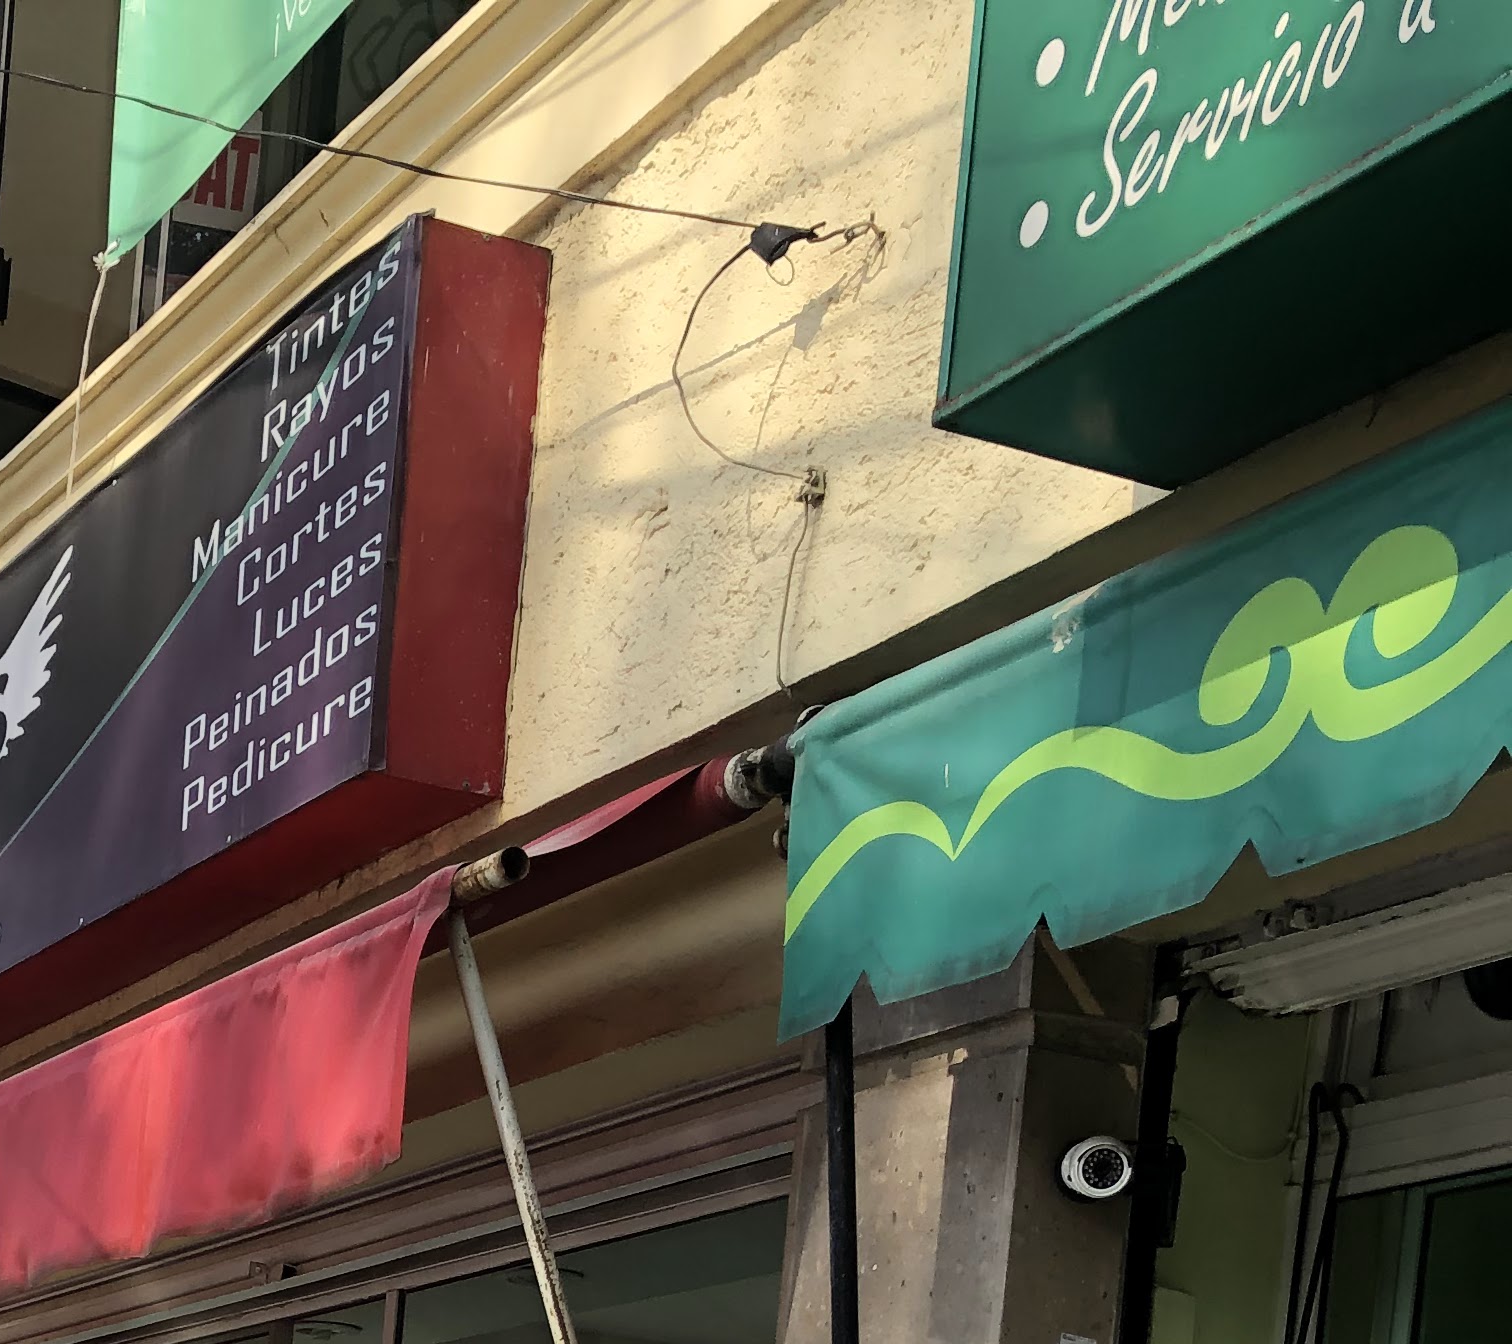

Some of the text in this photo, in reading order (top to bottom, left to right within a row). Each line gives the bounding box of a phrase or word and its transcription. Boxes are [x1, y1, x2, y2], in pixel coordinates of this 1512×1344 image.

[1076, 0, 1365, 237] Servicio
[260, 315, 395, 464] Rayos
[266, 240, 403, 392] Tintes
[191, 389, 390, 584] Manicure
[237, 459, 387, 607] Cortes
[253, 531, 383, 658] Luces
[181, 674, 374, 832] Pedicure
[182, 602, 379, 770] Peinados
